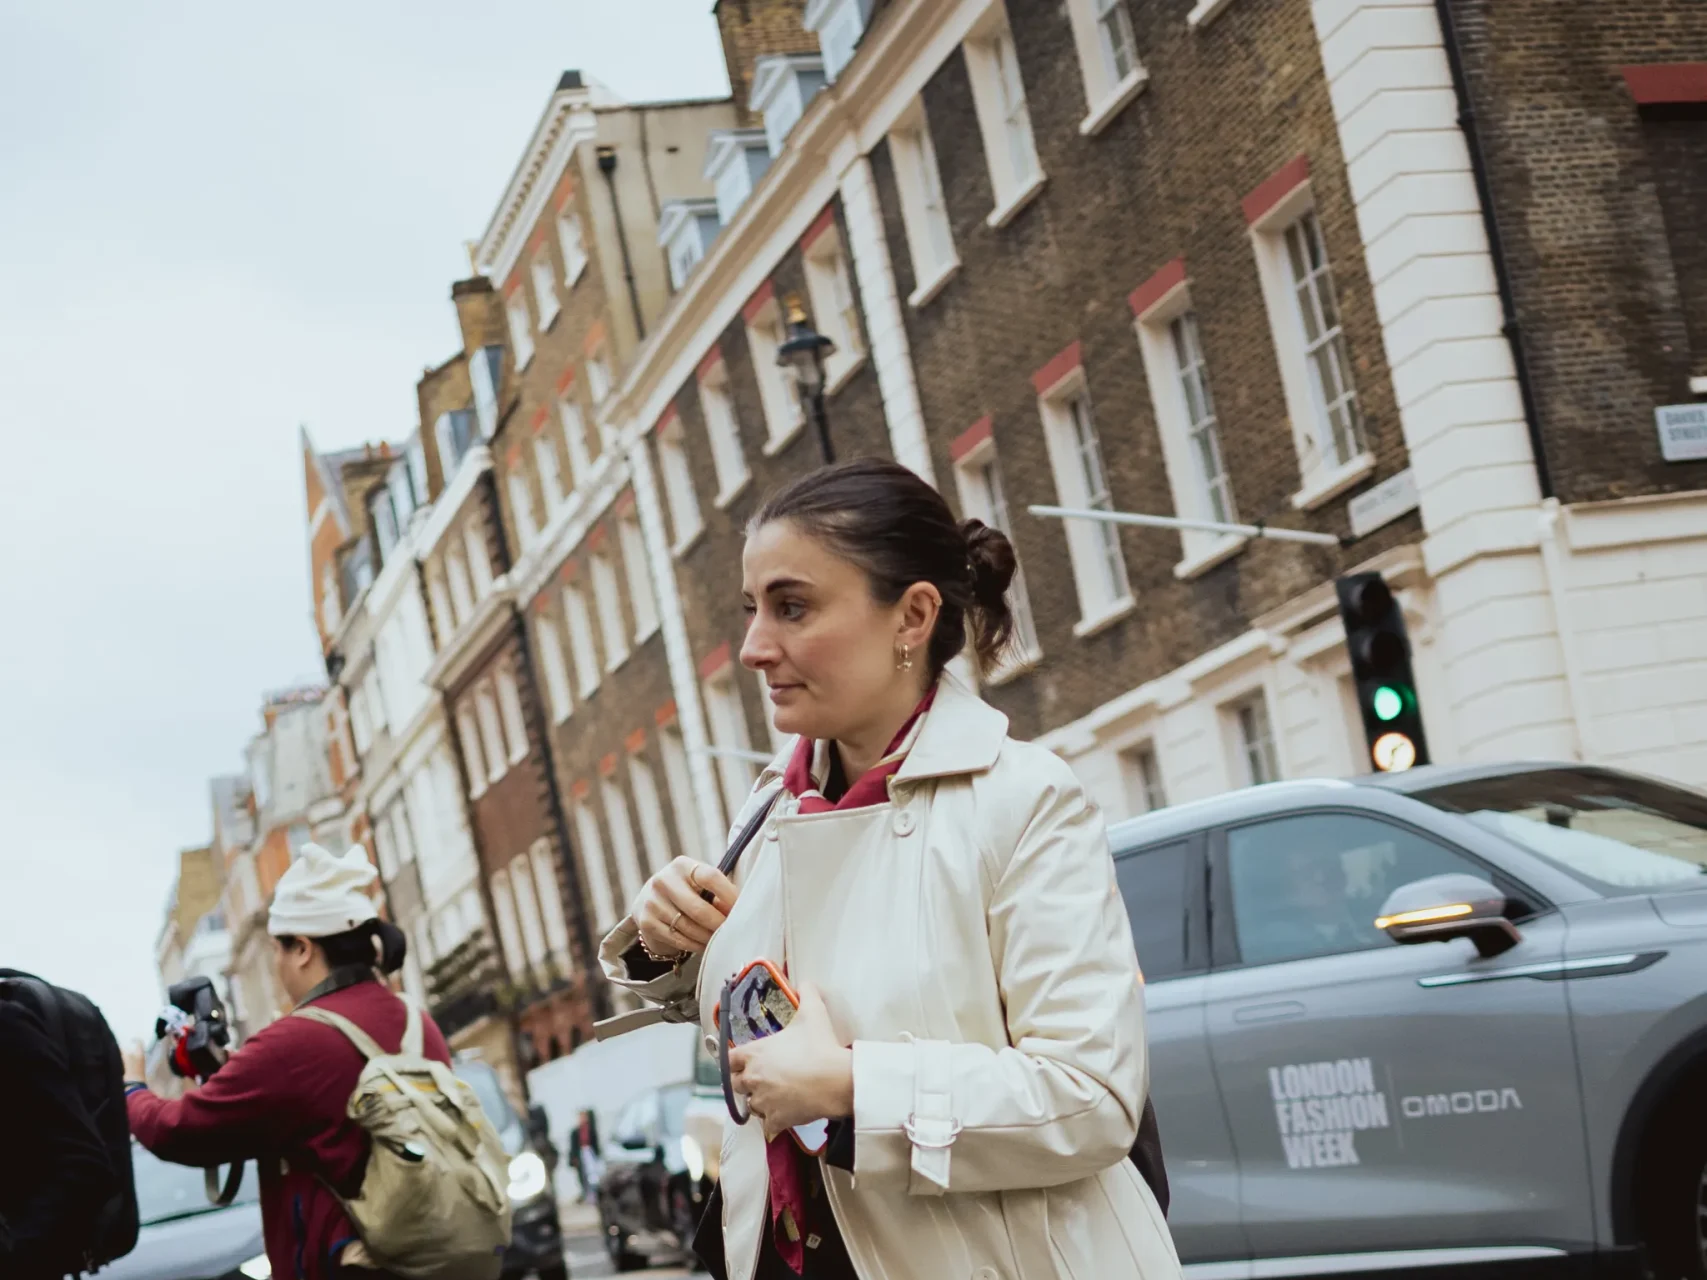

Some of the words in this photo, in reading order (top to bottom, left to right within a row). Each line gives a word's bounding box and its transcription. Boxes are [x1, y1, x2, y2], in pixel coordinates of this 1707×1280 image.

[1268, 1057, 1376, 1100] LONDON
[1275, 1091, 1389, 1136] FASHION
[1402, 1087, 1523, 1117] OMODA
[1281, 1130, 1360, 1169] WEEK
